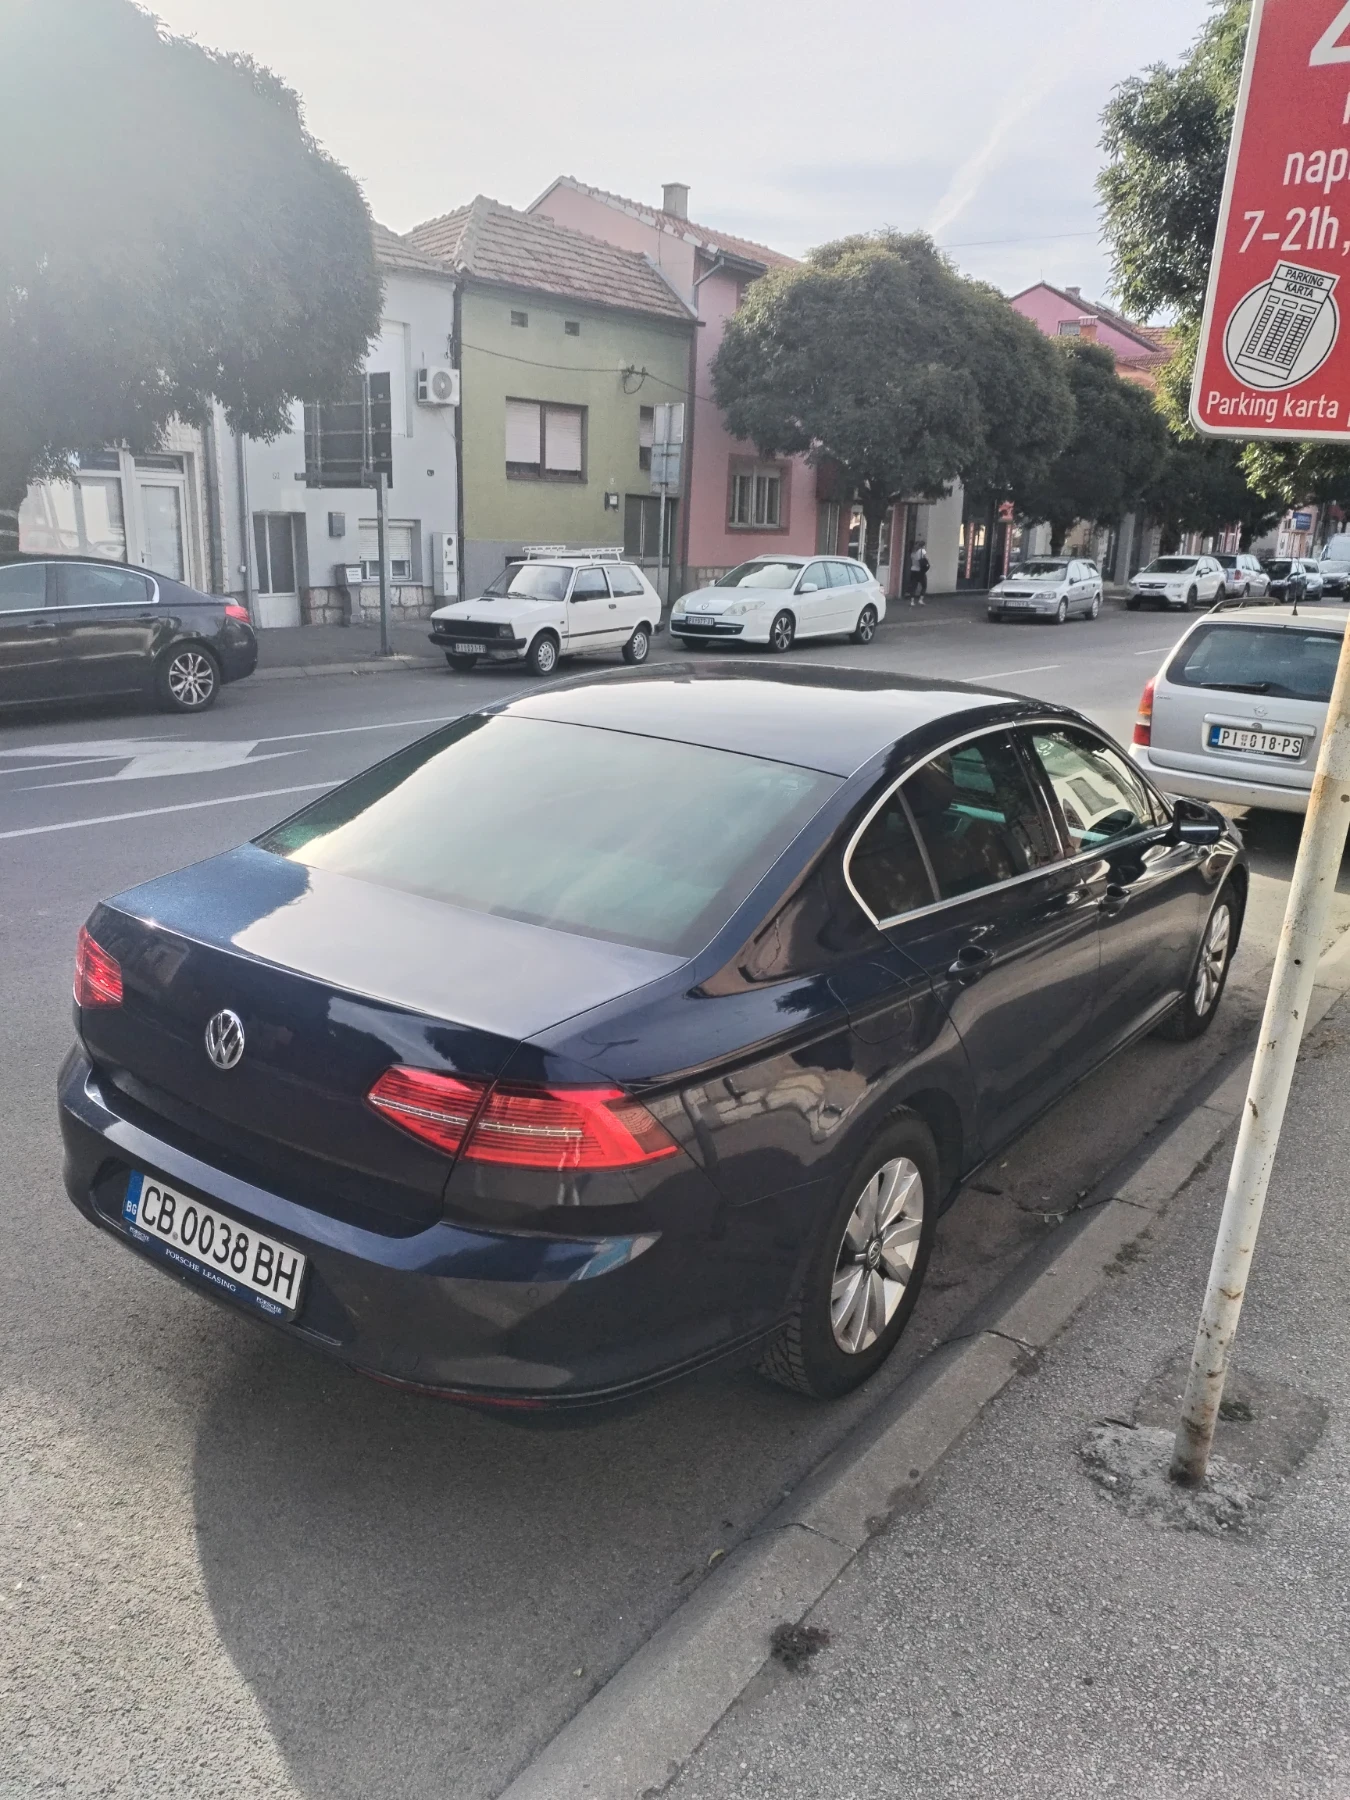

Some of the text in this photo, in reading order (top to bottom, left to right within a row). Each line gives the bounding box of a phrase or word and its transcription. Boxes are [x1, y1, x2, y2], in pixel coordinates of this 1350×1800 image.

[1283, 147, 1350, 195] nap
[1284, 282, 1314, 298] KARTA
[1285, 269, 1325, 287] PARKING
[1206, 391, 1278, 423] Parking
[1282, 392, 1340, 419] karta
[126, 1200, 137, 1216] BG
[165, 1248, 237, 1292] PORSCHE LEASING
